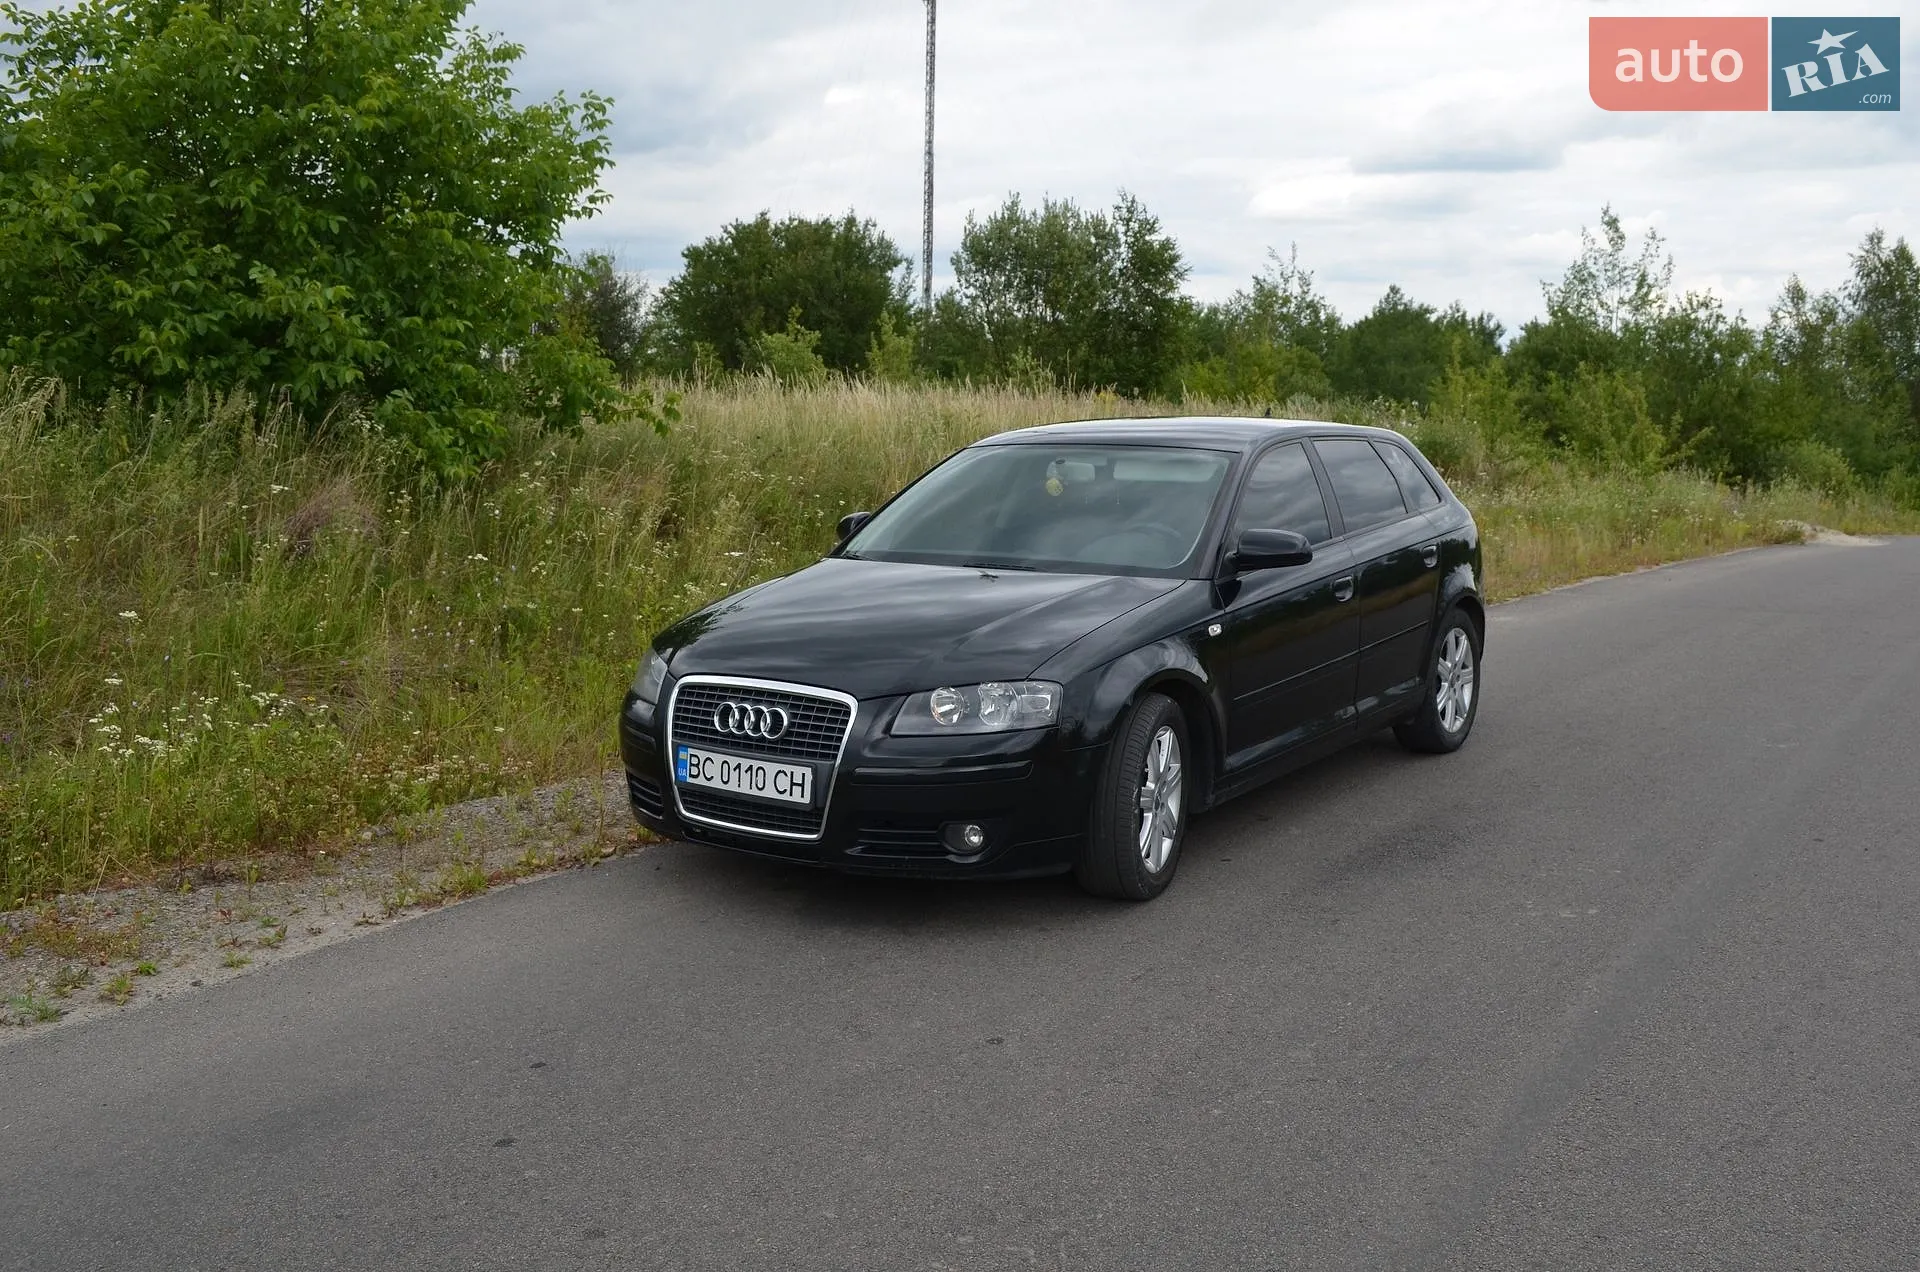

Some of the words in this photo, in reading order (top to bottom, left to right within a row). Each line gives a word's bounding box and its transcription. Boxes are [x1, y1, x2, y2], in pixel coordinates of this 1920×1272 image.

[678, 768, 687, 777] UA
[688, 754, 714, 781] BC
[720, 760, 766, 791] 0110
[774, 769, 806, 798] CH
